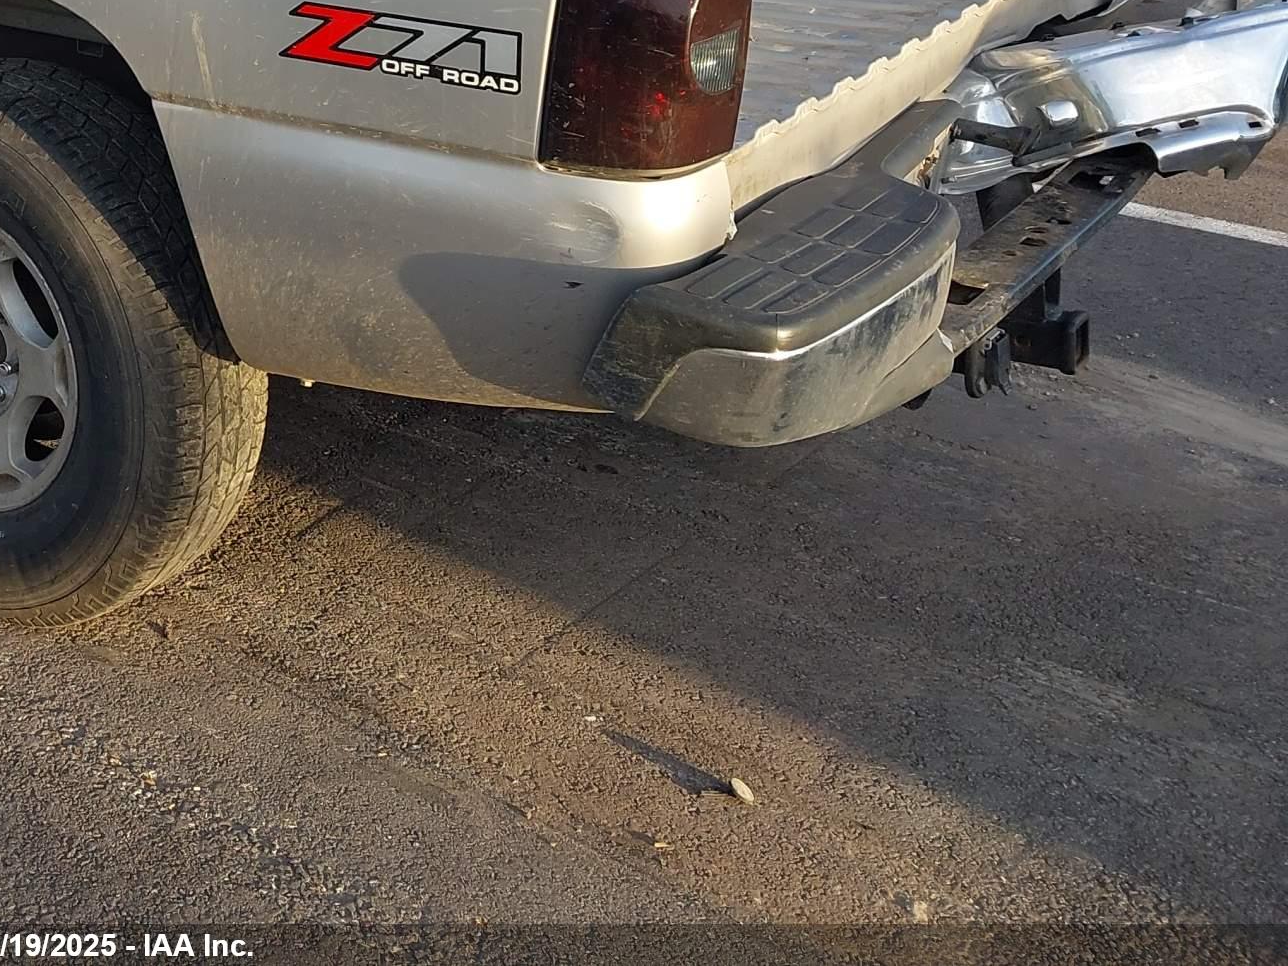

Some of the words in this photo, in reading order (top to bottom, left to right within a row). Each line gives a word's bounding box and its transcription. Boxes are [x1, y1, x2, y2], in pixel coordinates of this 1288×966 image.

[279, 1, 523, 77] Z71
[381, 59, 430, 77] OFF
[442, 70, 520, 93] ROAD
